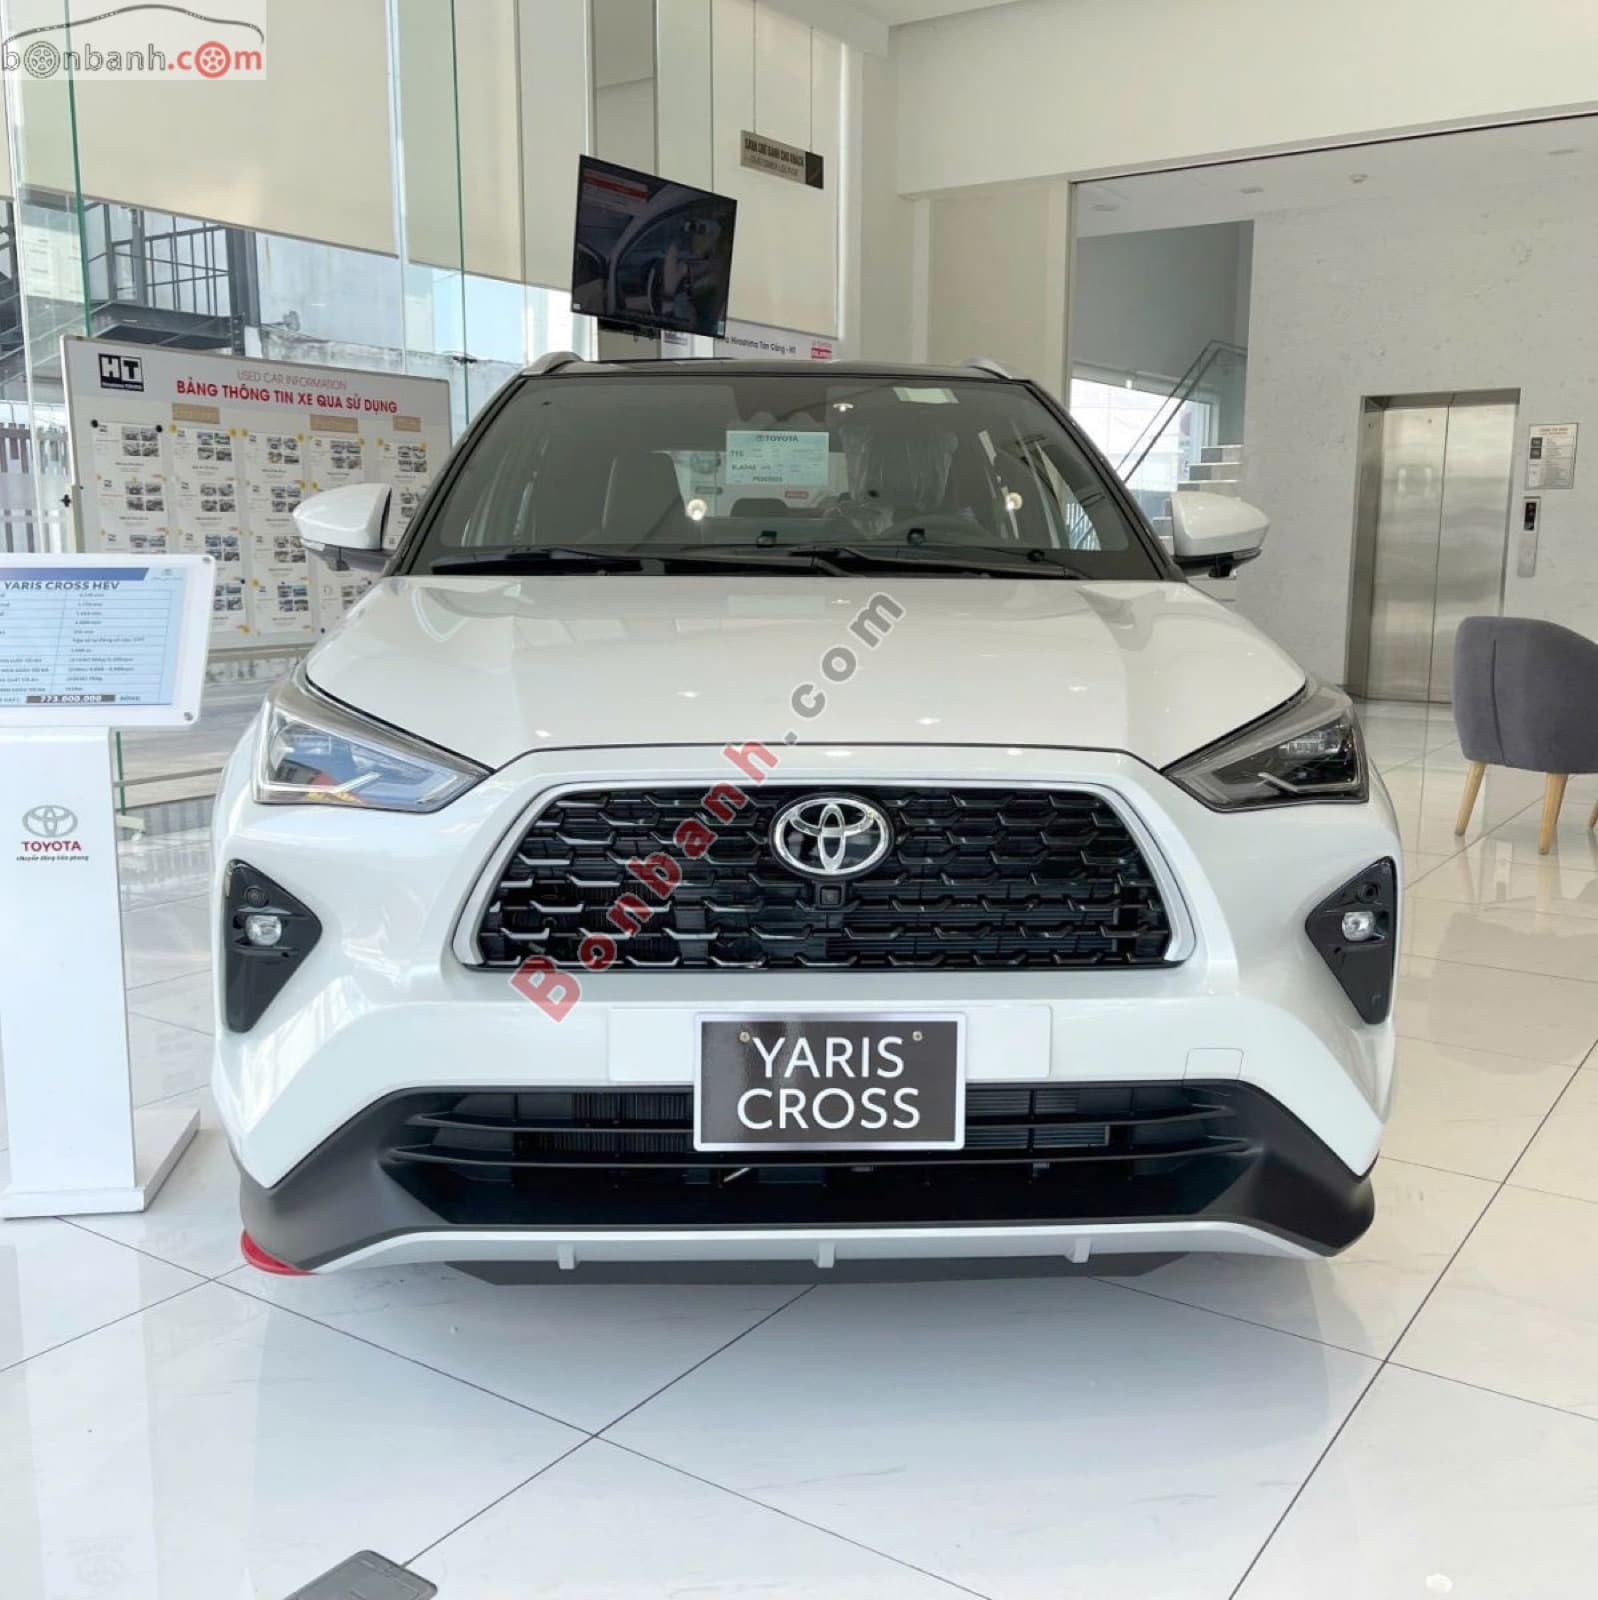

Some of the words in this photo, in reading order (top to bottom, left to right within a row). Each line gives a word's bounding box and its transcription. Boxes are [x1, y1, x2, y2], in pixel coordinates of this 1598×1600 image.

[101, 357, 140, 380] HT
[237, 369, 262, 382] USED
[263, 371, 285, 385] CAR
[286, 374, 348, 391] INFORMATION
[176, 376, 218, 397] BẢNG
[222, 383, 271, 402] THÔNG
[273, 390, 294, 404] TIN
[298, 392, 313, 406] XE
[316, 394, 343, 409] QUA
[346, 393, 361, 410] SỬ
[364, 398, 398, 415] DỤNG
[766, 434, 800, 442] TOYOTA
[4, 581, 42, 590] YARIS
[45, 581, 90, 590] CROSS
[92, 581, 120, 590] HEV
[21, 840, 82, 852] TOYOTA
[752, 1036, 905, 1079] YARIS
[736, 1087, 921, 1130] CROSS
